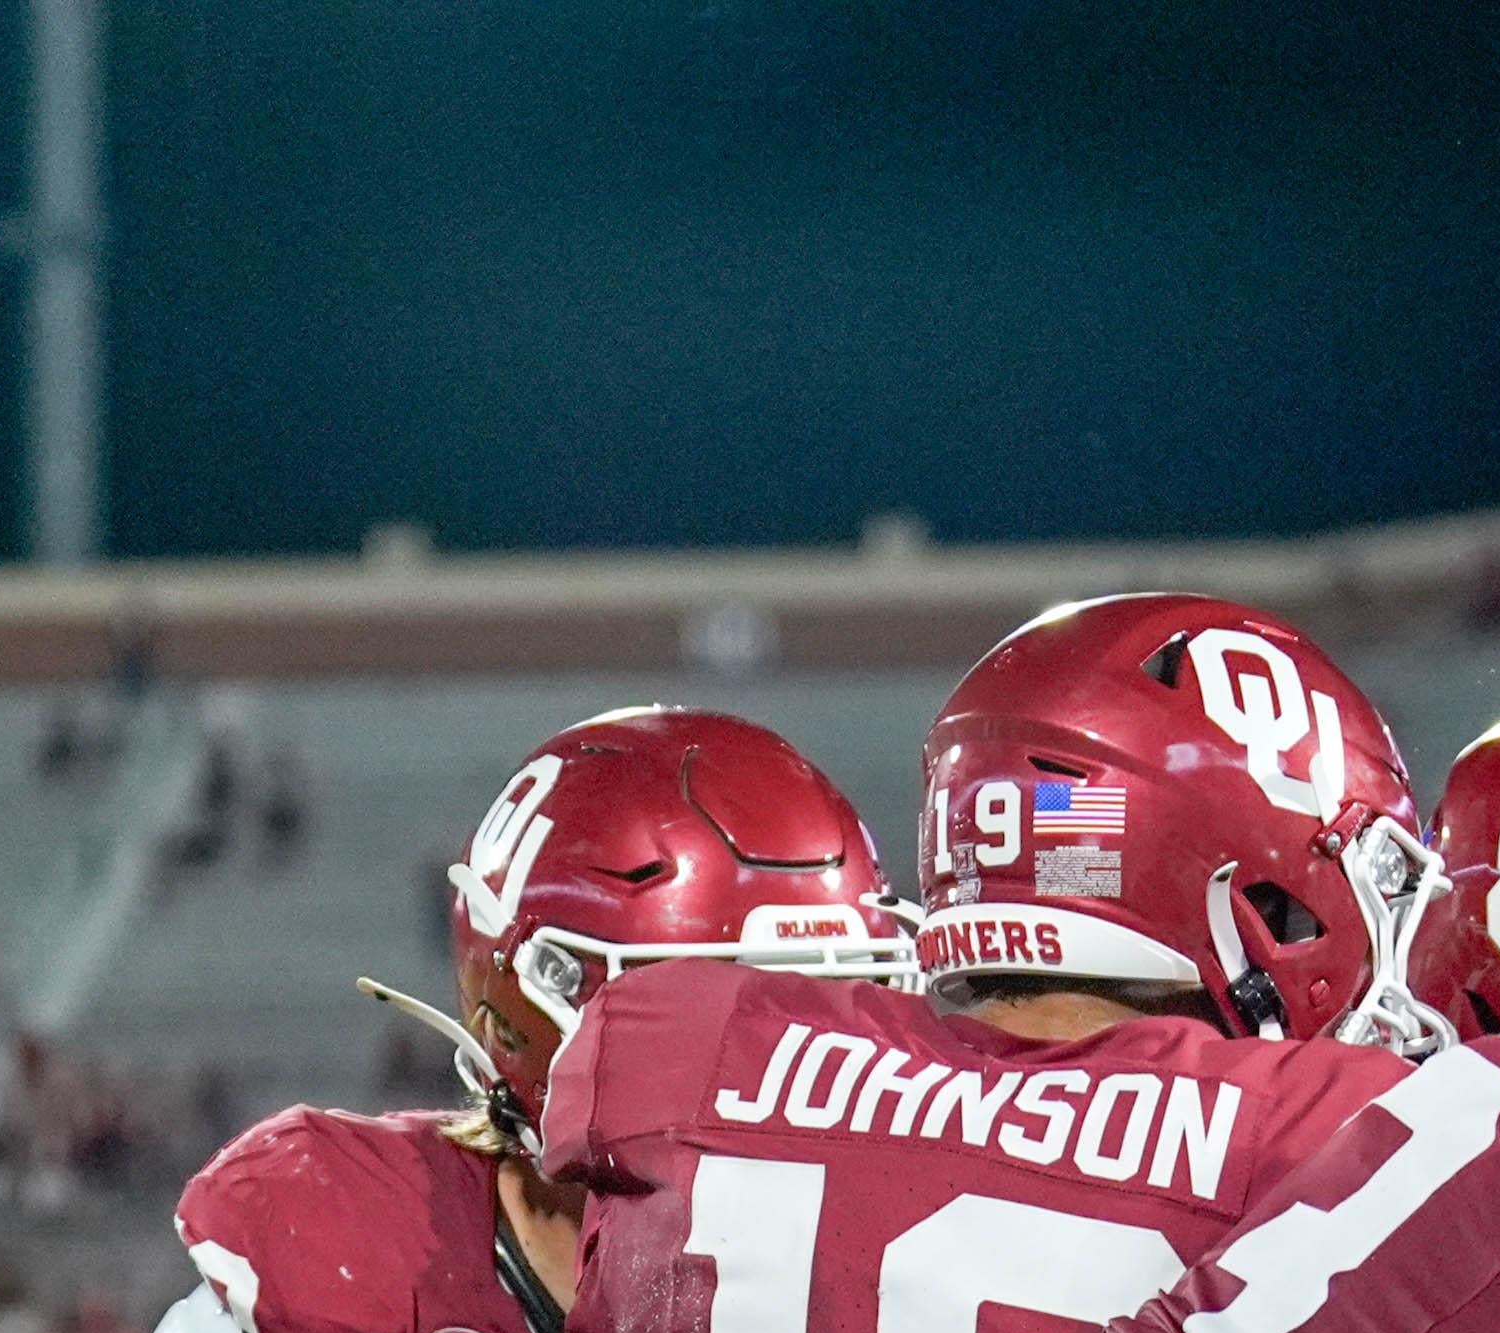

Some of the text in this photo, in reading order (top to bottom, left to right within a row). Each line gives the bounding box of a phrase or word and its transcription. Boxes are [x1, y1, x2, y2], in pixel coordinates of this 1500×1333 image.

[1186, 627, 1346, 820] OU
[934, 781, 1021, 875] 19
[776, 919, 848, 938] OKLAHOMA
[715, 1022, 1243, 1202] JOHNSON
